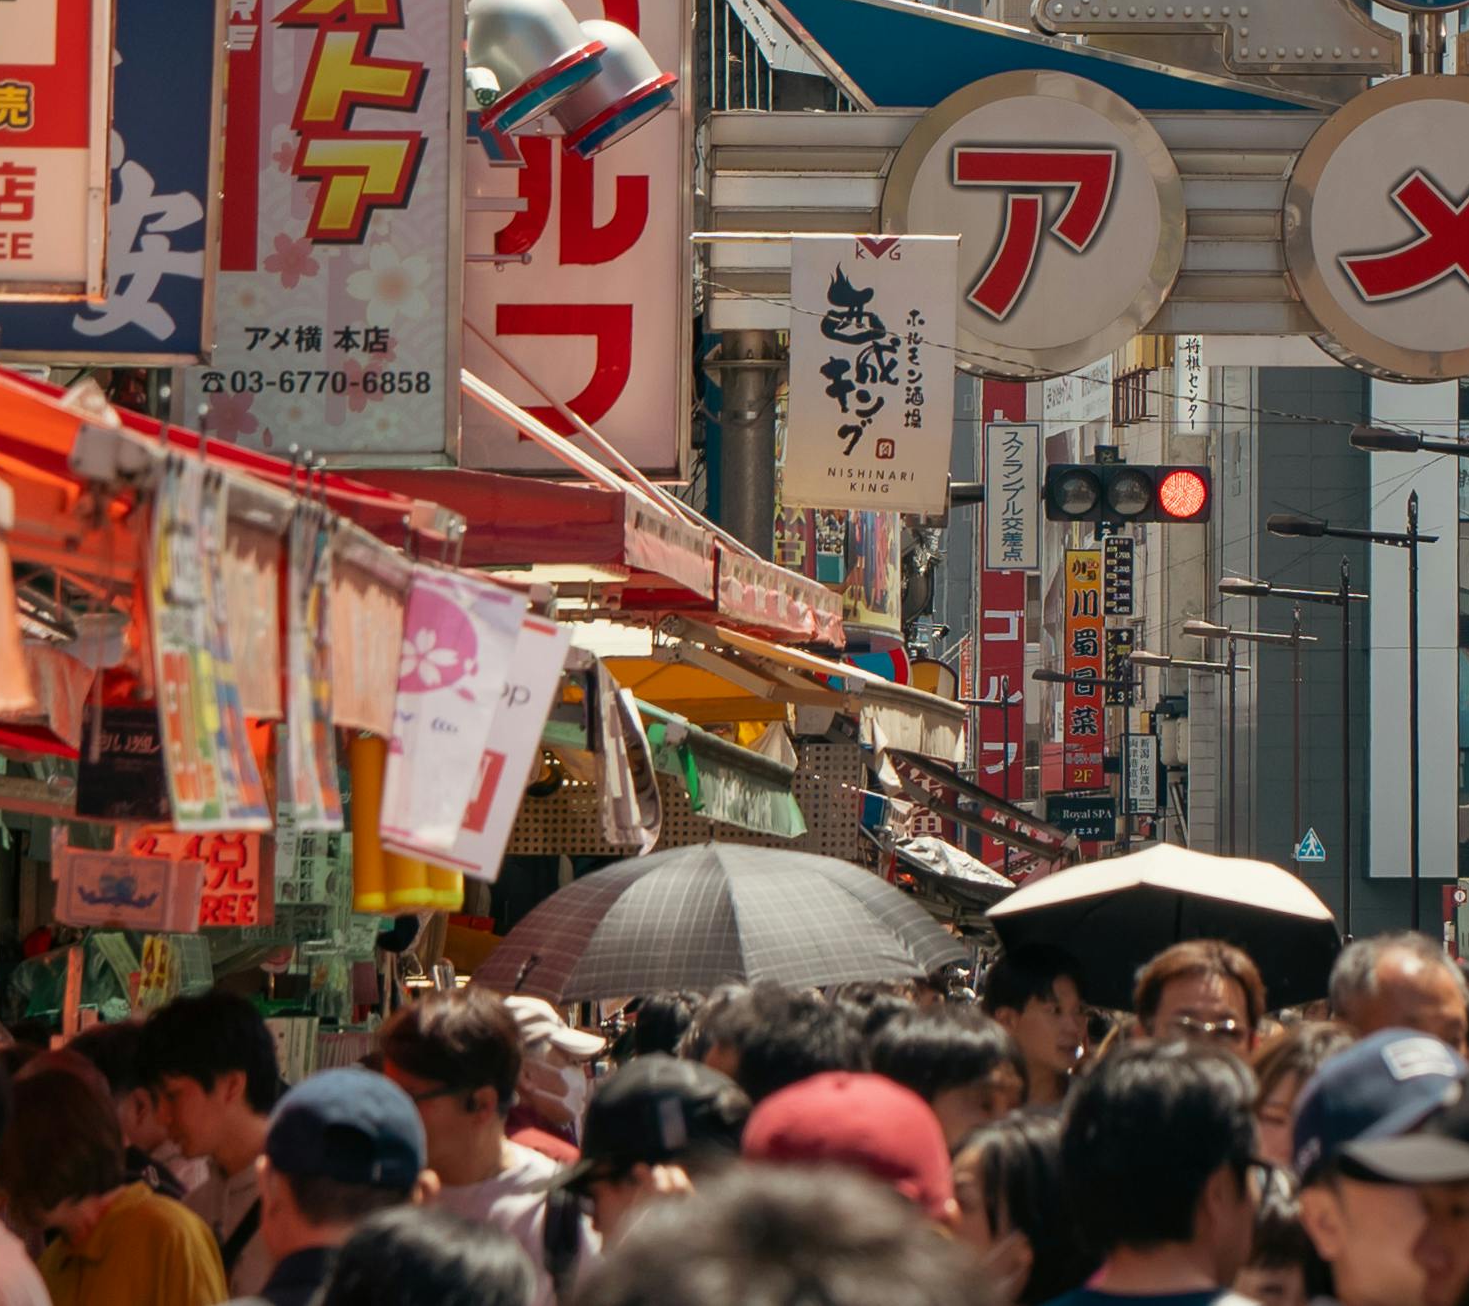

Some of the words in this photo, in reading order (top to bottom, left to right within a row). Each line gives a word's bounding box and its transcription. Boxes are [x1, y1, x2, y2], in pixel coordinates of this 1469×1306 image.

[243, 326, 323, 353] アメ横
[332, 326, 390, 353] 本店
[903, 308, 926, 429] ホルモン酒場
[230, 370, 431, 395] 03-6770-6858
[1185, 336, 1202, 431] 将棋センター
[827, 467, 915, 483] NISHINARI
[849, 481, 891, 494] KING
[1001, 430, 1024, 563] スクランブル交差点
[983, 608, 1024, 775] ゴルフ
[1073, 768, 1094, 784] 2F
[1062, 809, 1091, 822] Royal
[1092, 809, 1112, 819] SPA
[200, 893, 258, 925] REE
